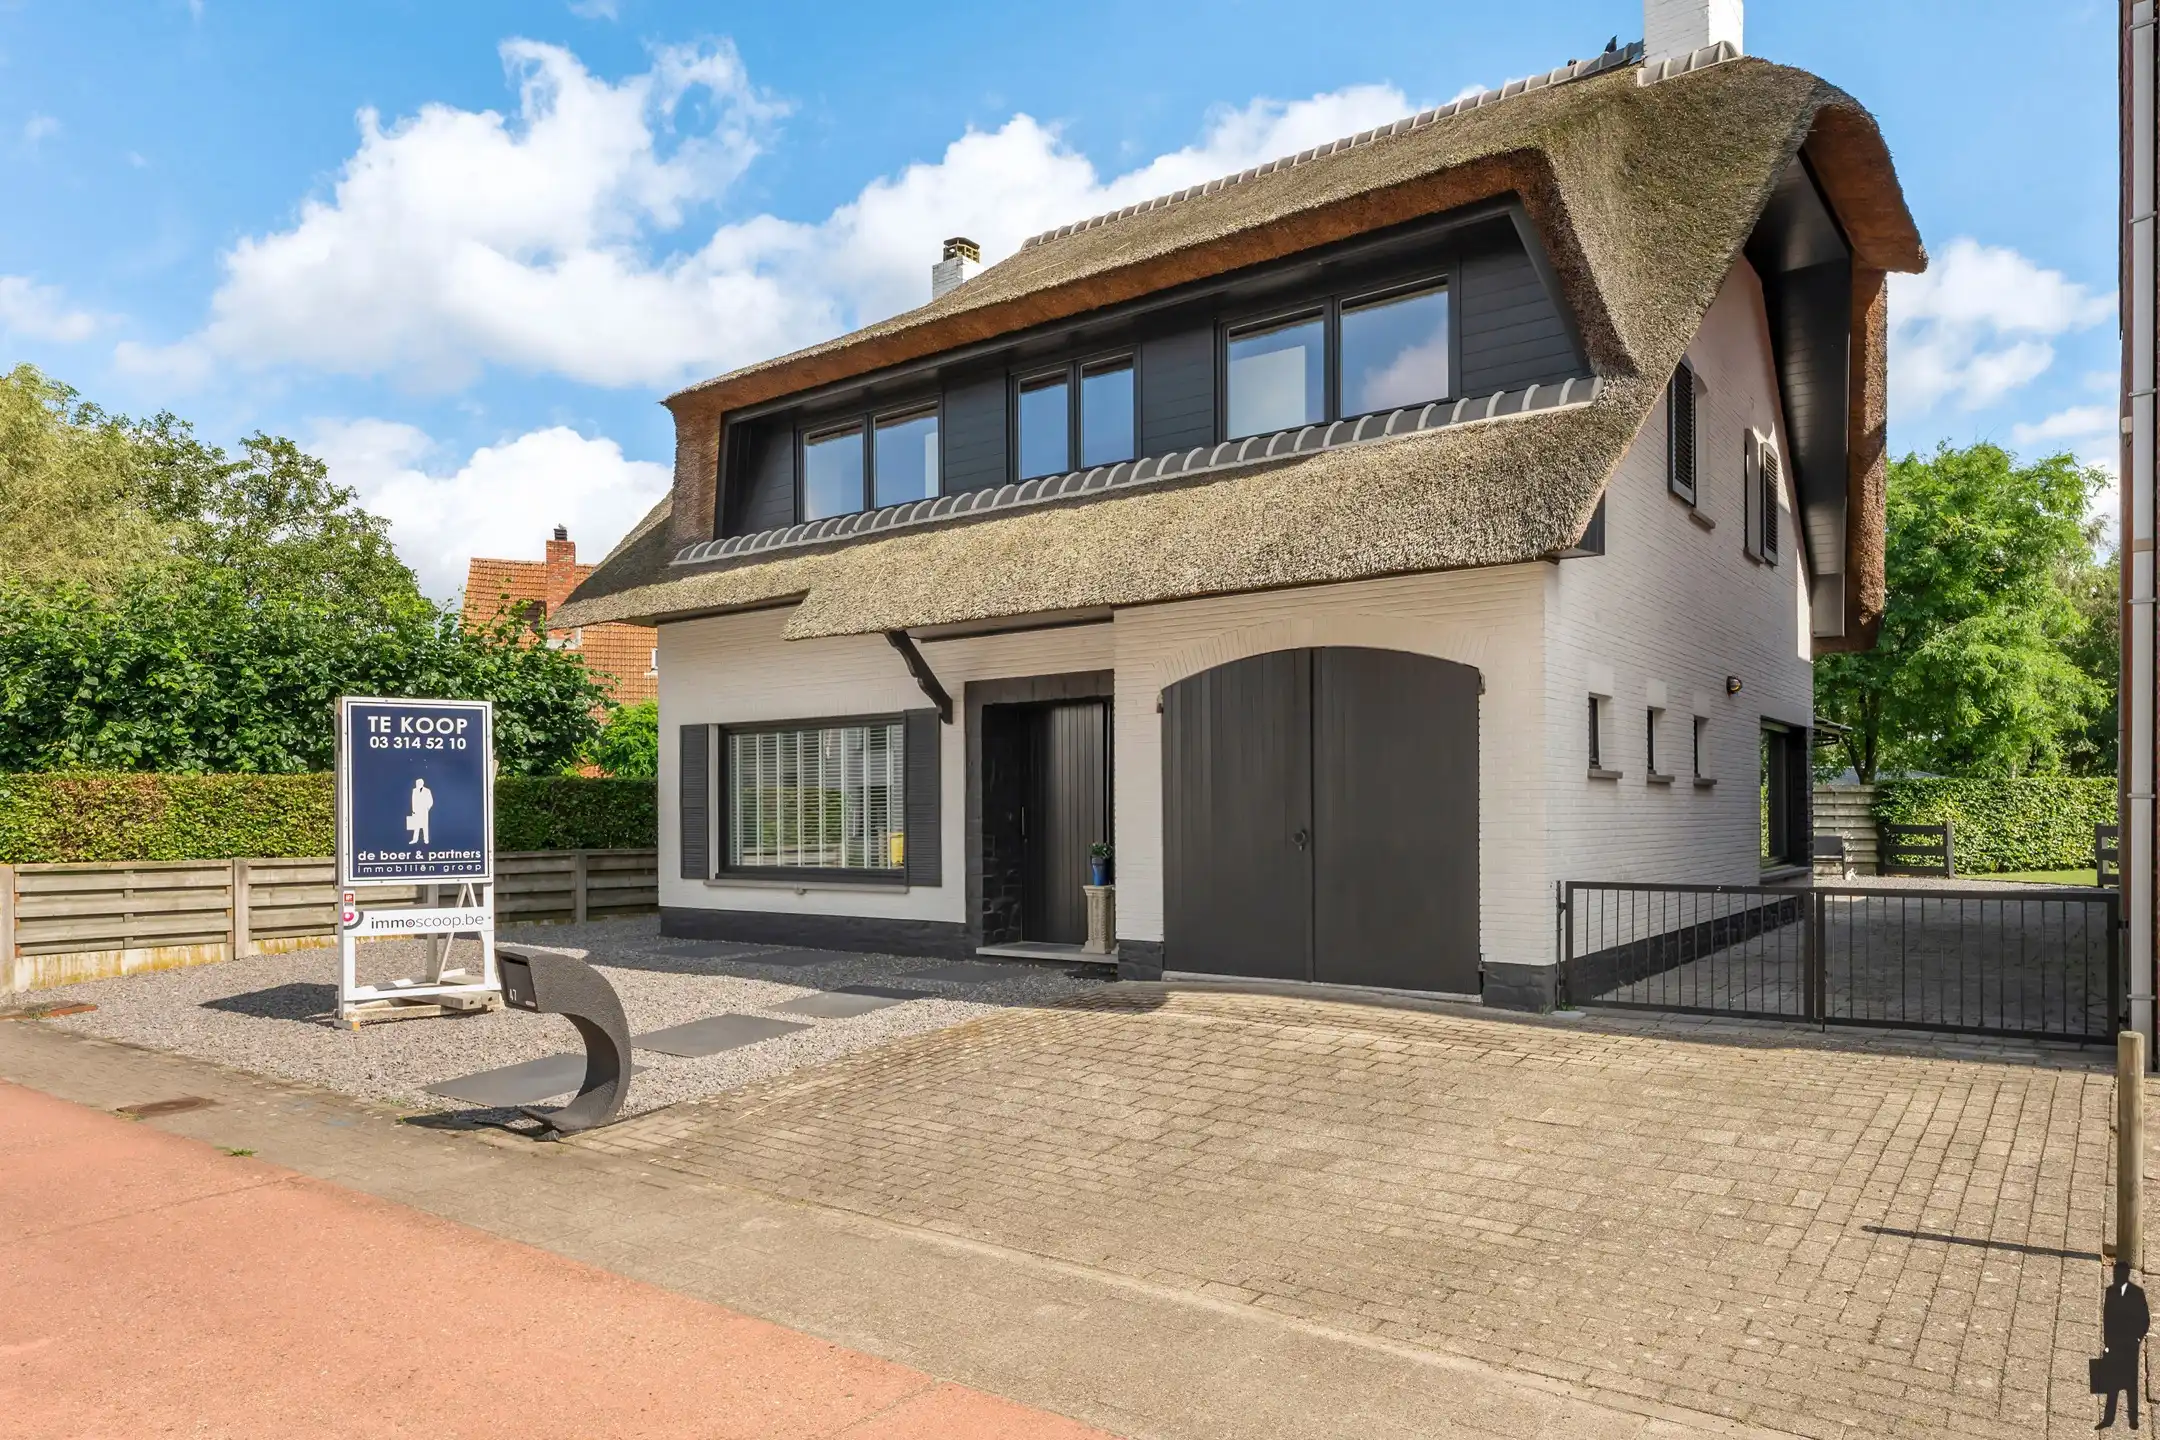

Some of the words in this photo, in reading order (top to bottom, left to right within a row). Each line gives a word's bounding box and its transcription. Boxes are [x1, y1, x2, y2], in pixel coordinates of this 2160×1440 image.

[367, 715, 391, 733] TE
[400, 716, 468, 735] KOOP
[370, 736, 388, 748] 03
[393, 736, 421, 749] 314
[425, 737, 443, 749] 52
[449, 737, 466, 750] 10
[358, 850, 375, 860] de
[380, 850, 411, 860] boer
[415, 850, 424, 860] &
[428, 849, 481, 861] partners
[357, 864, 435, 873] immobiliën
[443, 864, 481, 873] groep
[371, 913, 485, 930] immoscoop.be
[509, 988, 517, 1001] 47
